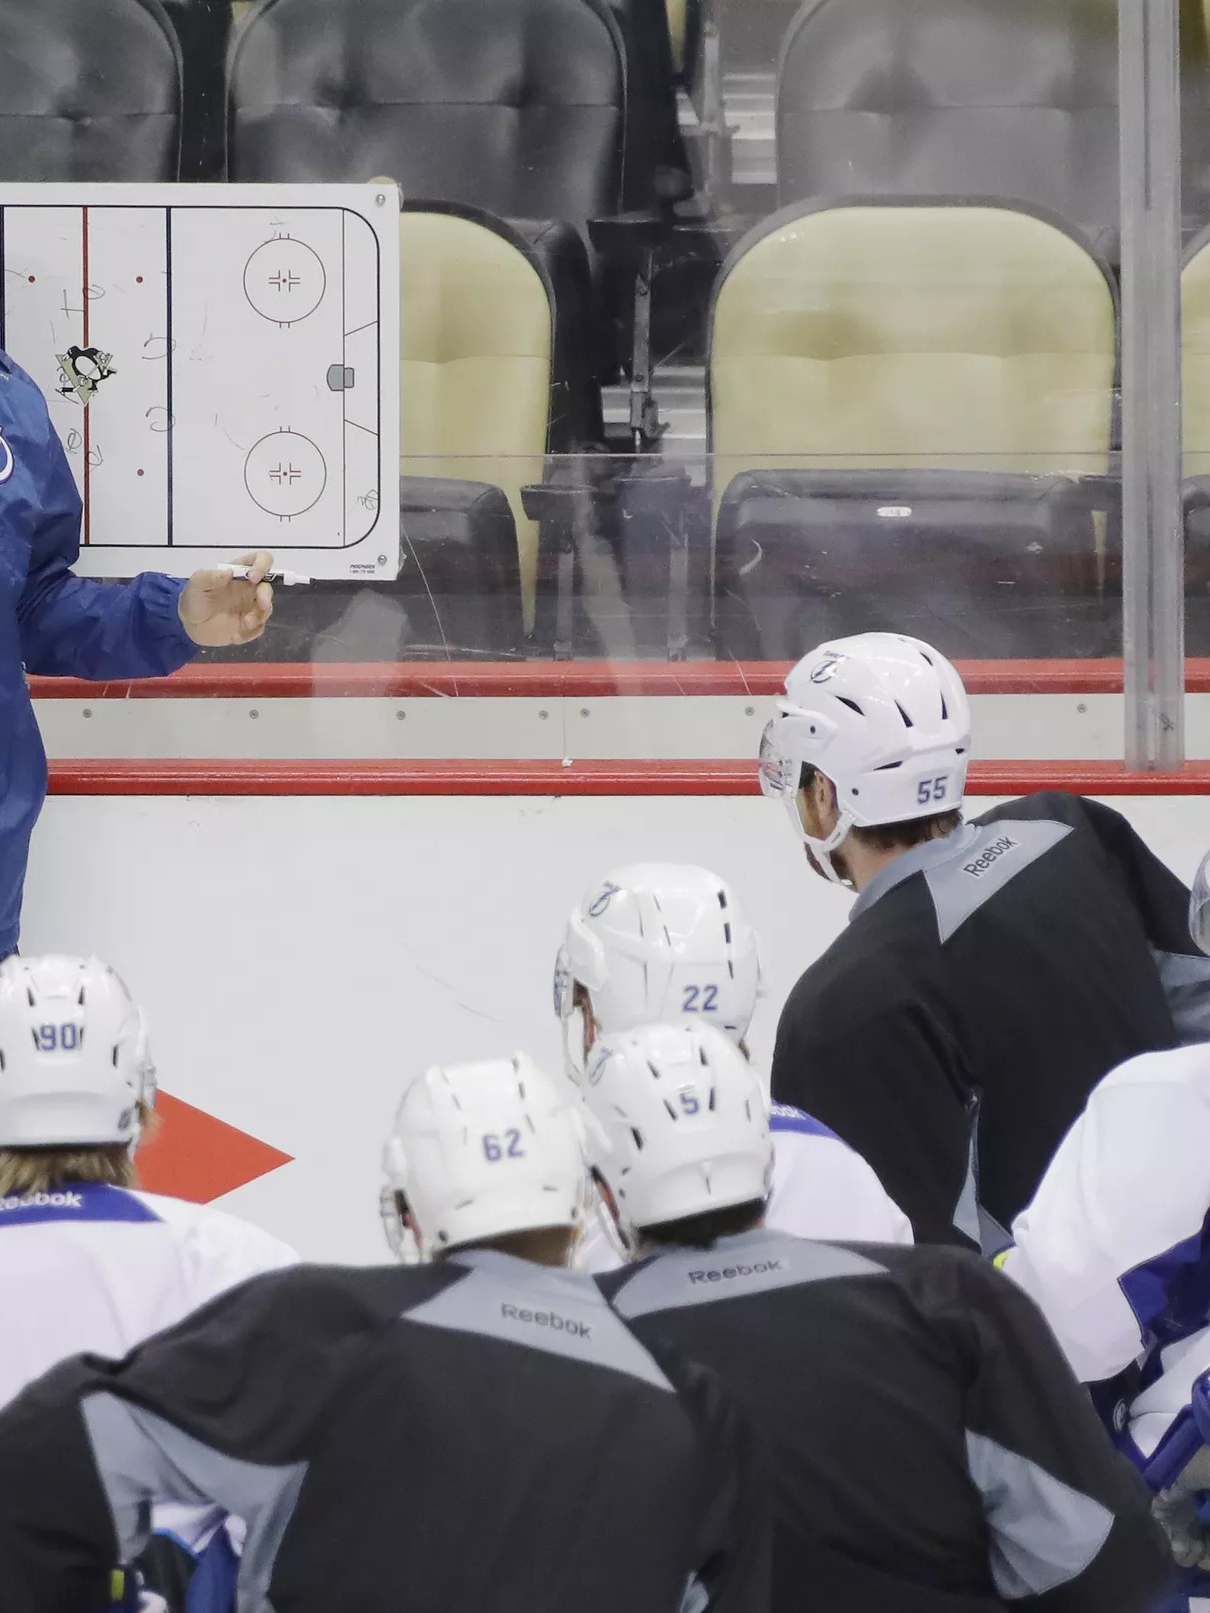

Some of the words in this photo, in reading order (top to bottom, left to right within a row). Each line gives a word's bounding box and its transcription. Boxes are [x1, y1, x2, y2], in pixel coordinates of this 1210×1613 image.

[917, 776, 948, 805] 55
[963, 836, 1018, 877] Reebok
[683, 984, 718, 1012] 22
[40, 1023, 76, 1051] 90
[482, 1129, 526, 1162] 62
[688, 1260, 783, 1284] Reebok
[501, 1302, 592, 1341] Reebok
